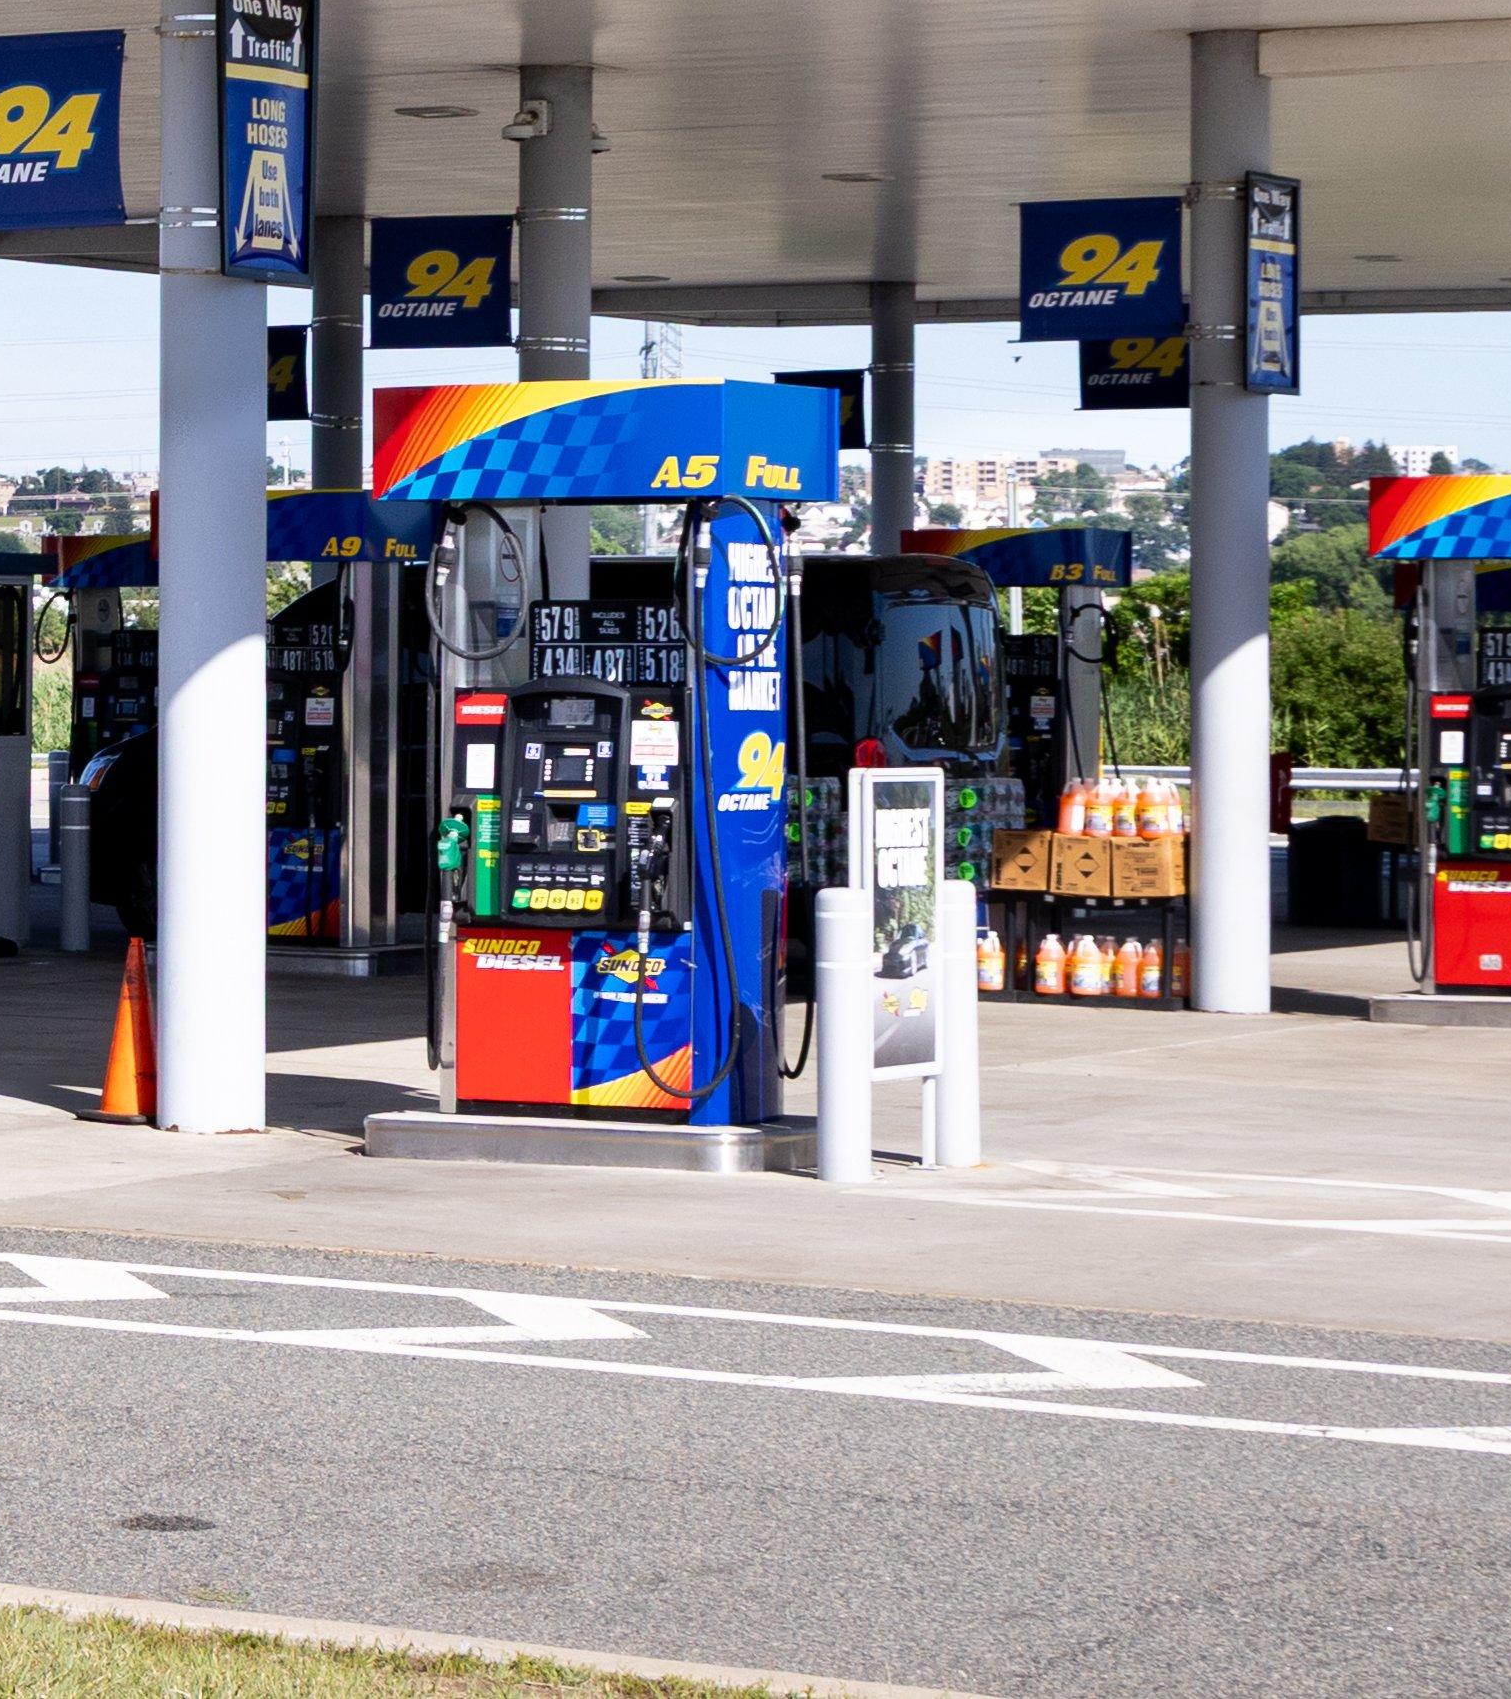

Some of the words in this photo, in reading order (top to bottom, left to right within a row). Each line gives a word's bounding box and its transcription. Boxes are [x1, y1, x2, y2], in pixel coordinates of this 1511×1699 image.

[247, 35, 292, 63] Traffic
[251, 97, 286, 123] LONG
[247, 123, 288, 149] HOSES
[262, 160, 278, 181] Use
[259, 187, 279, 208] both
[254, 214, 283, 240] lanes
[1057, 234, 1165, 295] 94
[403, 250, 497, 309] 94
[378, 301, 459, 318] OCTANE
[1029, 290, 1118, 309] OCTANE
[1109, 337, 1187, 376] 94
[267, 354, 299, 393] 4
[1087, 373, 1154, 386] OCTANE
[652, 456, 720, 489] A5
[321, 536, 363, 557] A9
[1049, 564, 1084, 581] B3
[728, 586, 777, 630] OCTAN
[737, 732, 786, 801] 94
[718, 794, 771, 812] OCTANE
[463, 939, 541, 955] SUNOCO
[476, 954, 565, 971] DIESEL
